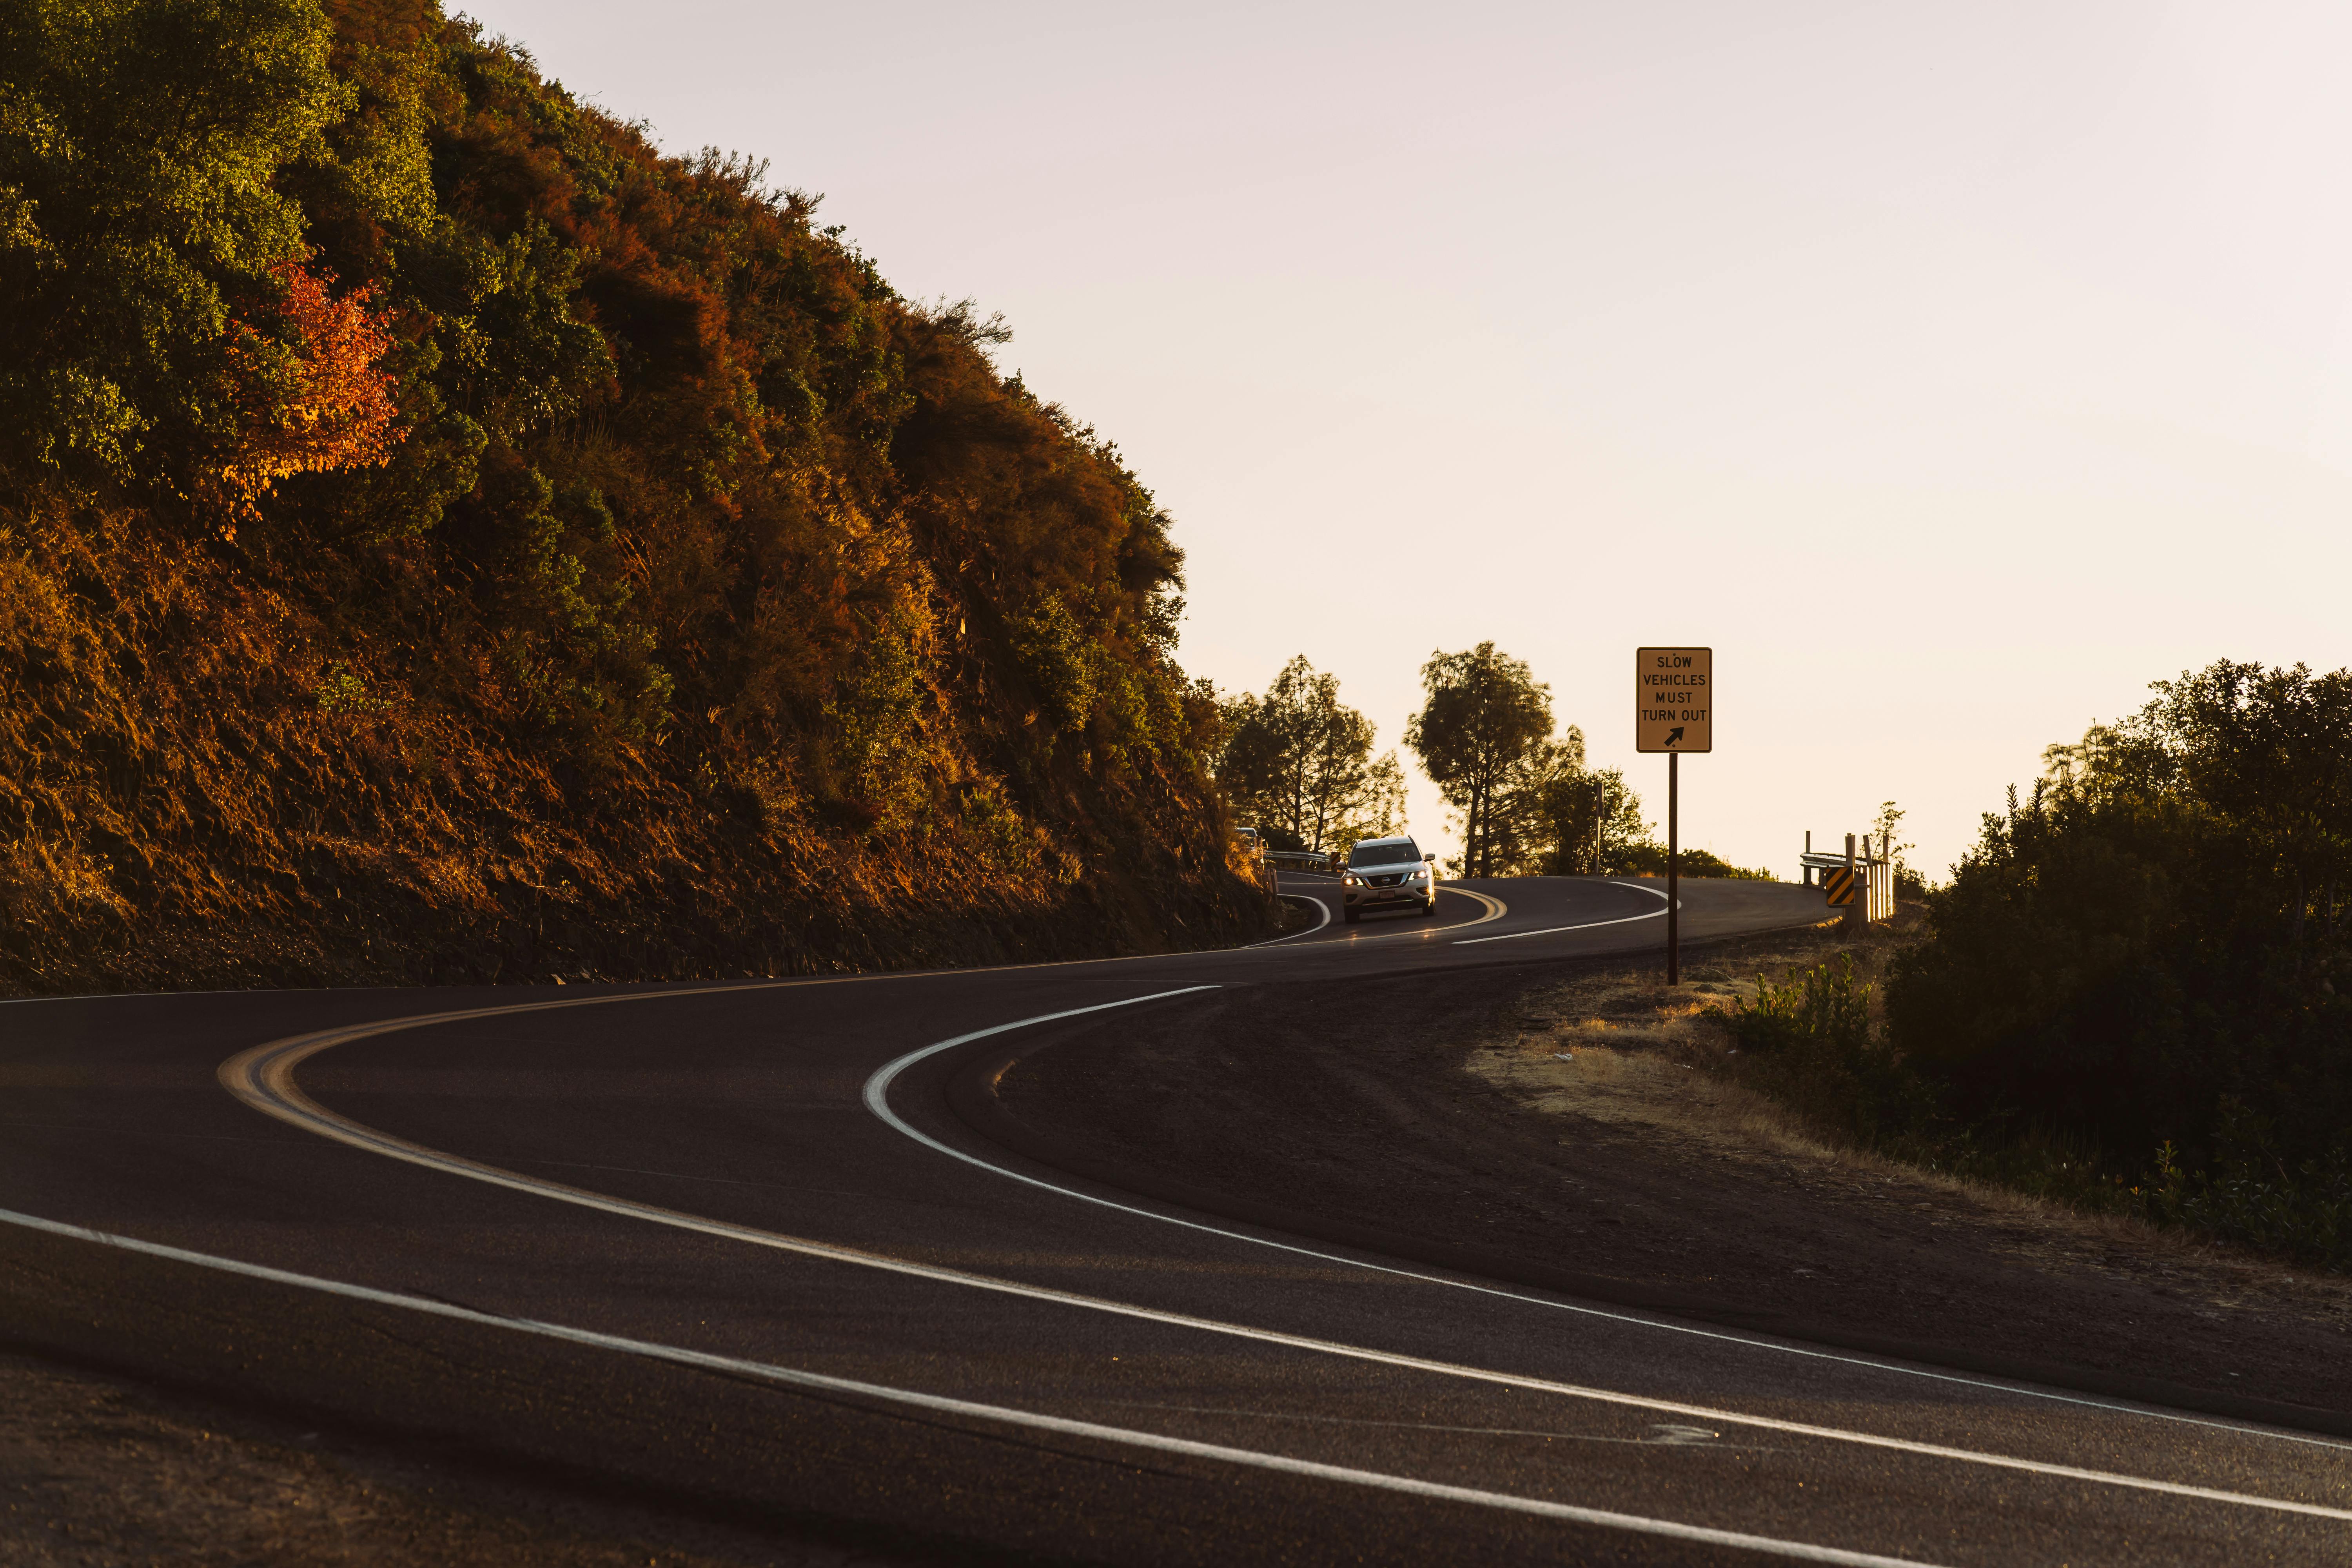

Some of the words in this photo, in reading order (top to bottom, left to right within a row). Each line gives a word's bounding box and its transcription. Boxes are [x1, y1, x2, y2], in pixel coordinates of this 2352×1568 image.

[1657, 657, 1691, 668] SLOW
[1643, 674, 1706, 686] VEHICLES
[1656, 692, 1692, 703] MUST
[1642, 710, 1675, 721] TURN
[1681, 710, 1706, 721] OUT
